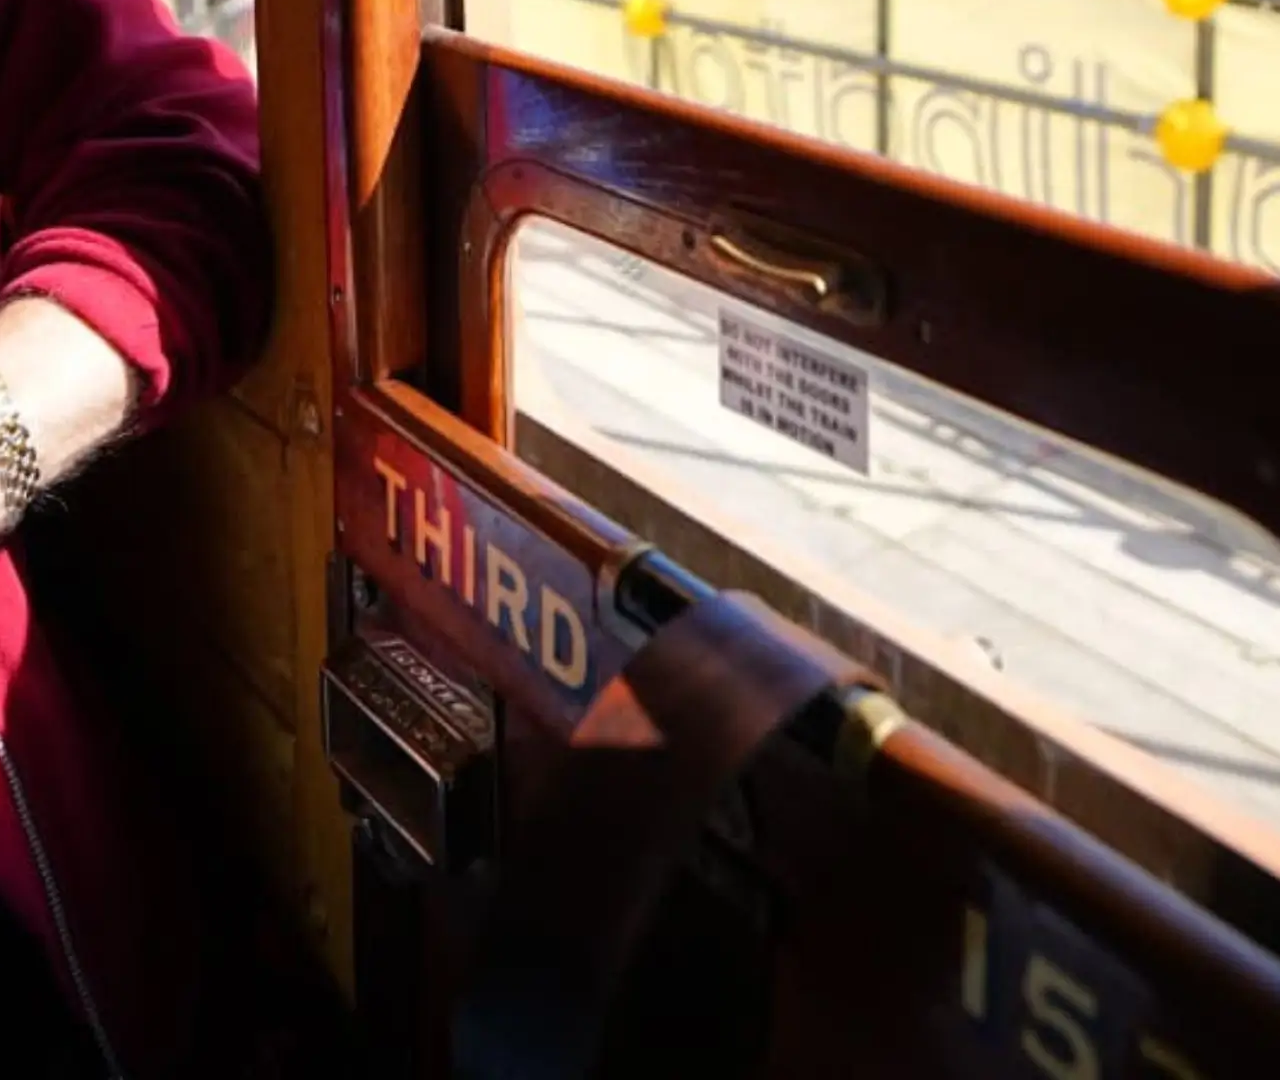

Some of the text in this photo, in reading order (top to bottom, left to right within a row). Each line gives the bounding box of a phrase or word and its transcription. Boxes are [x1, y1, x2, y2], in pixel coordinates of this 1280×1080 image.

[767, 362, 793, 390] THE
[778, 390, 805, 418] THE
[810, 405, 858, 443] TRAIN
[374, 455, 588, 690] THIRD
